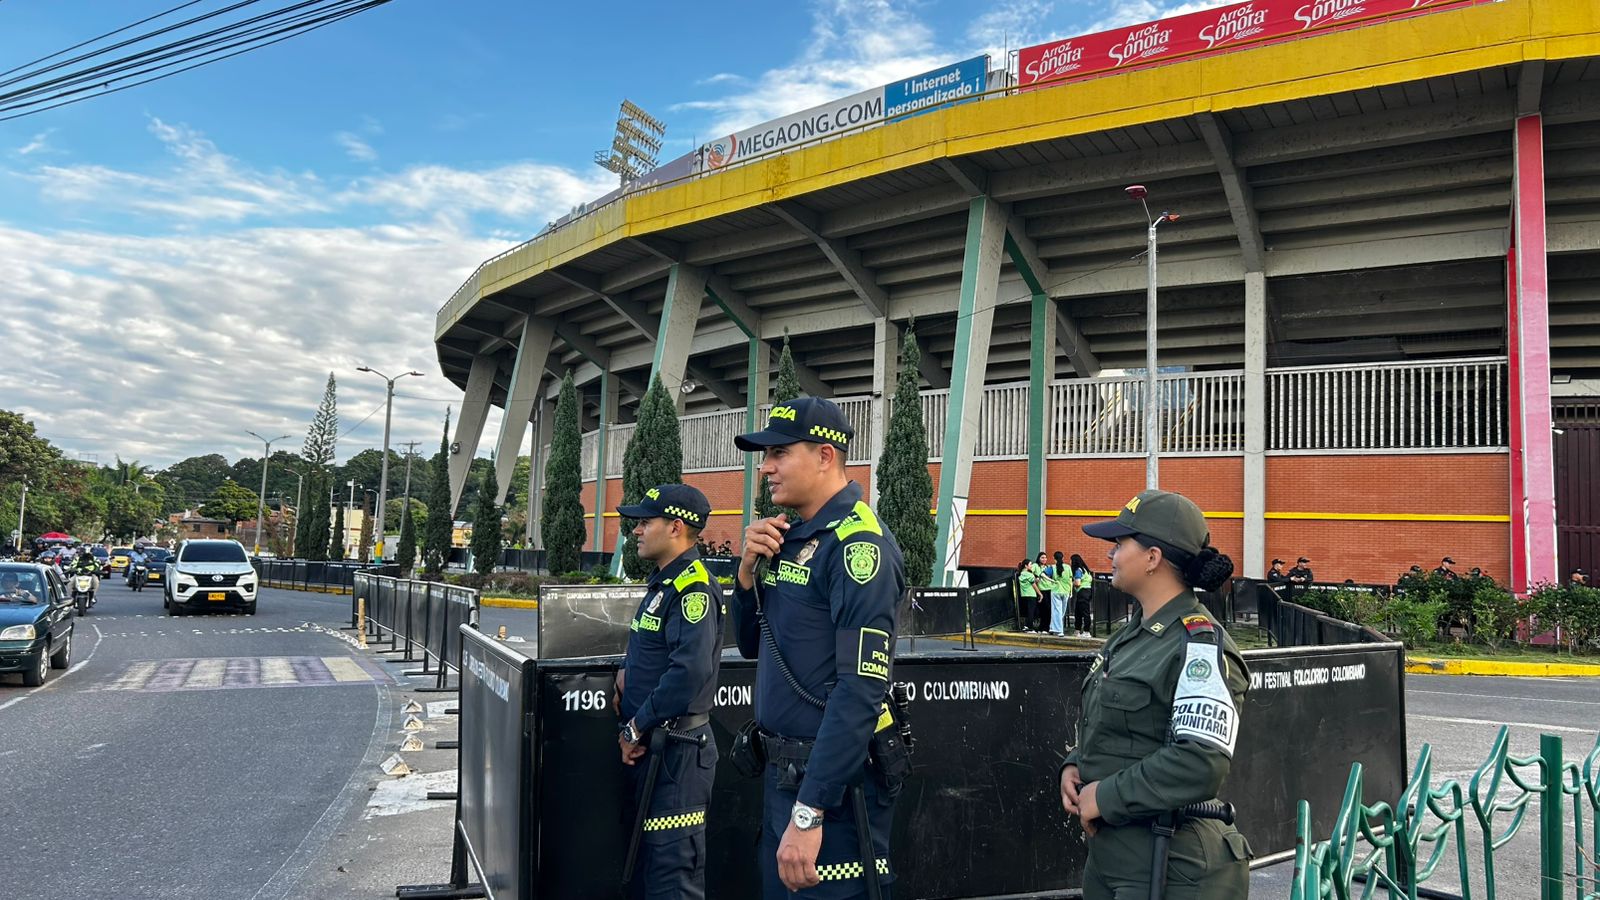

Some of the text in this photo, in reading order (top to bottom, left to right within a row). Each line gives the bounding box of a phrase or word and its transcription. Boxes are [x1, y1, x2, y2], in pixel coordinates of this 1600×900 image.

[1199, 9, 1266, 49] Sonora
[1217, 3, 1253, 25] Arroz
[1108, 29, 1171, 67] Sonora
[1126, 23, 1158, 44] Arroz
[1025, 48, 1082, 84] Sonora
[1041, 41, 1072, 61] Arroz
[911, 68, 961, 94] Internet
[887, 82, 972, 118] personalizado
[736, 97, 884, 159] MEGAONG.COM
[1264, 671, 1292, 690] FESTIVAL
[1293, 667, 1329, 687] FOLCLORICO
[1332, 663, 1366, 683] COLOMBIANO
[561, 688, 607, 712] 1196
[923, 680, 1010, 702] COLOMBIANO
